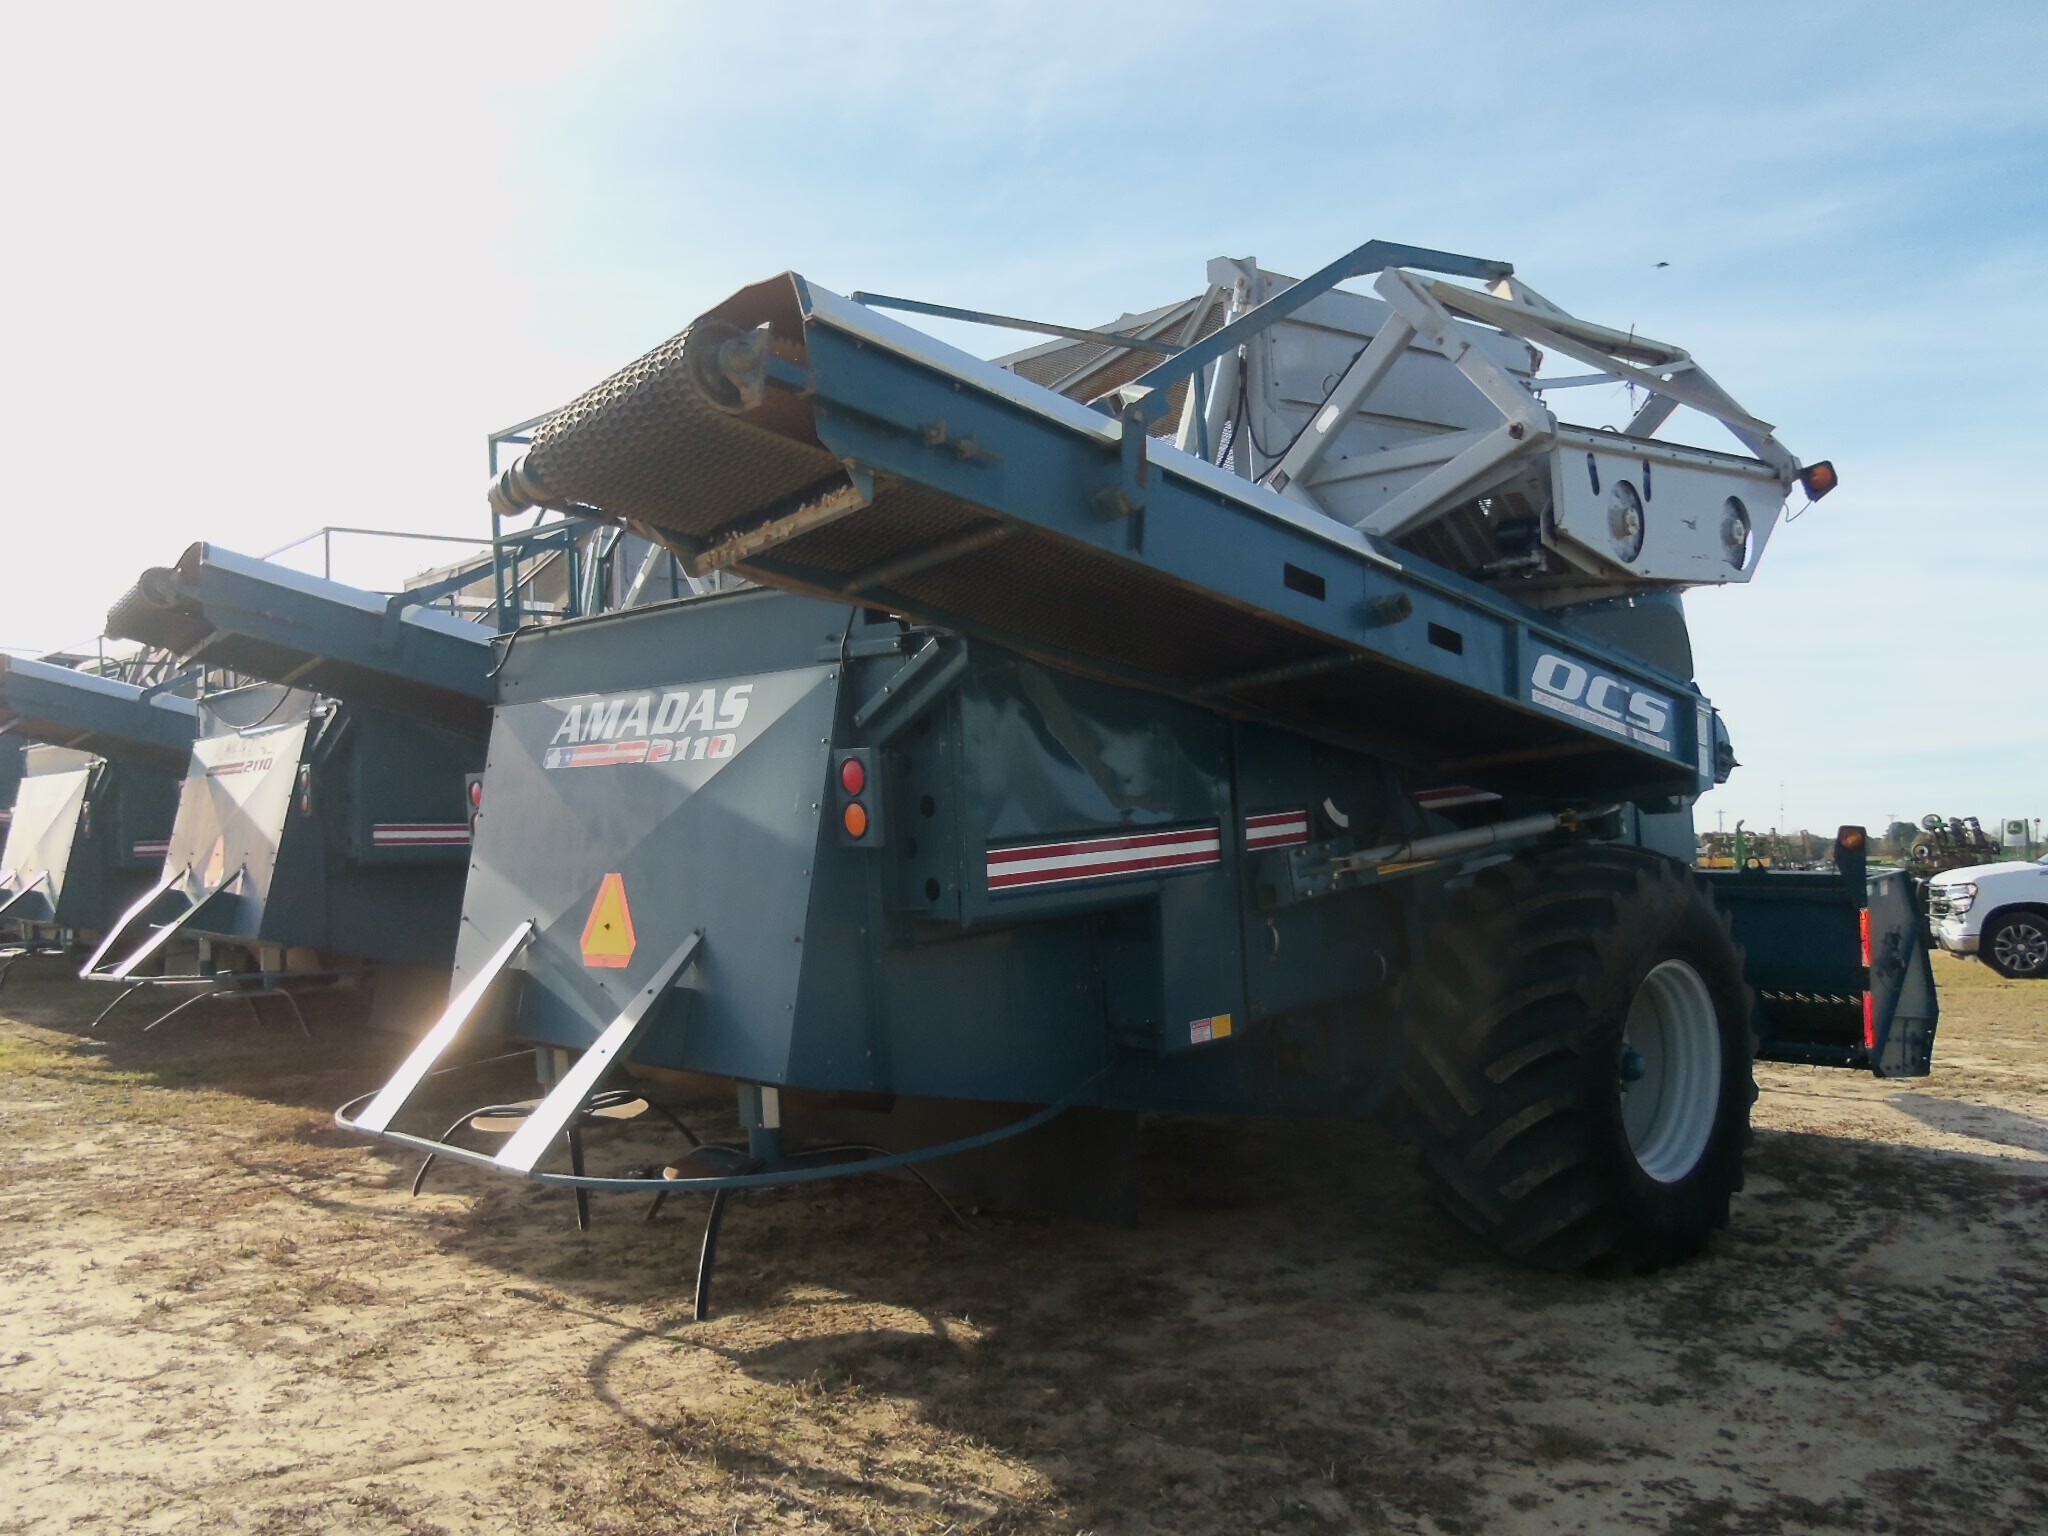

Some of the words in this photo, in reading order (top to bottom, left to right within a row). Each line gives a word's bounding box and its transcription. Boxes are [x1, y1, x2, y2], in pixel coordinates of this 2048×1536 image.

[550, 684, 753, 745] AMADAS
[1531, 654, 1669, 733] OCS
[244, 758, 273, 773] 2110
[646, 733, 737, 763] 2110
